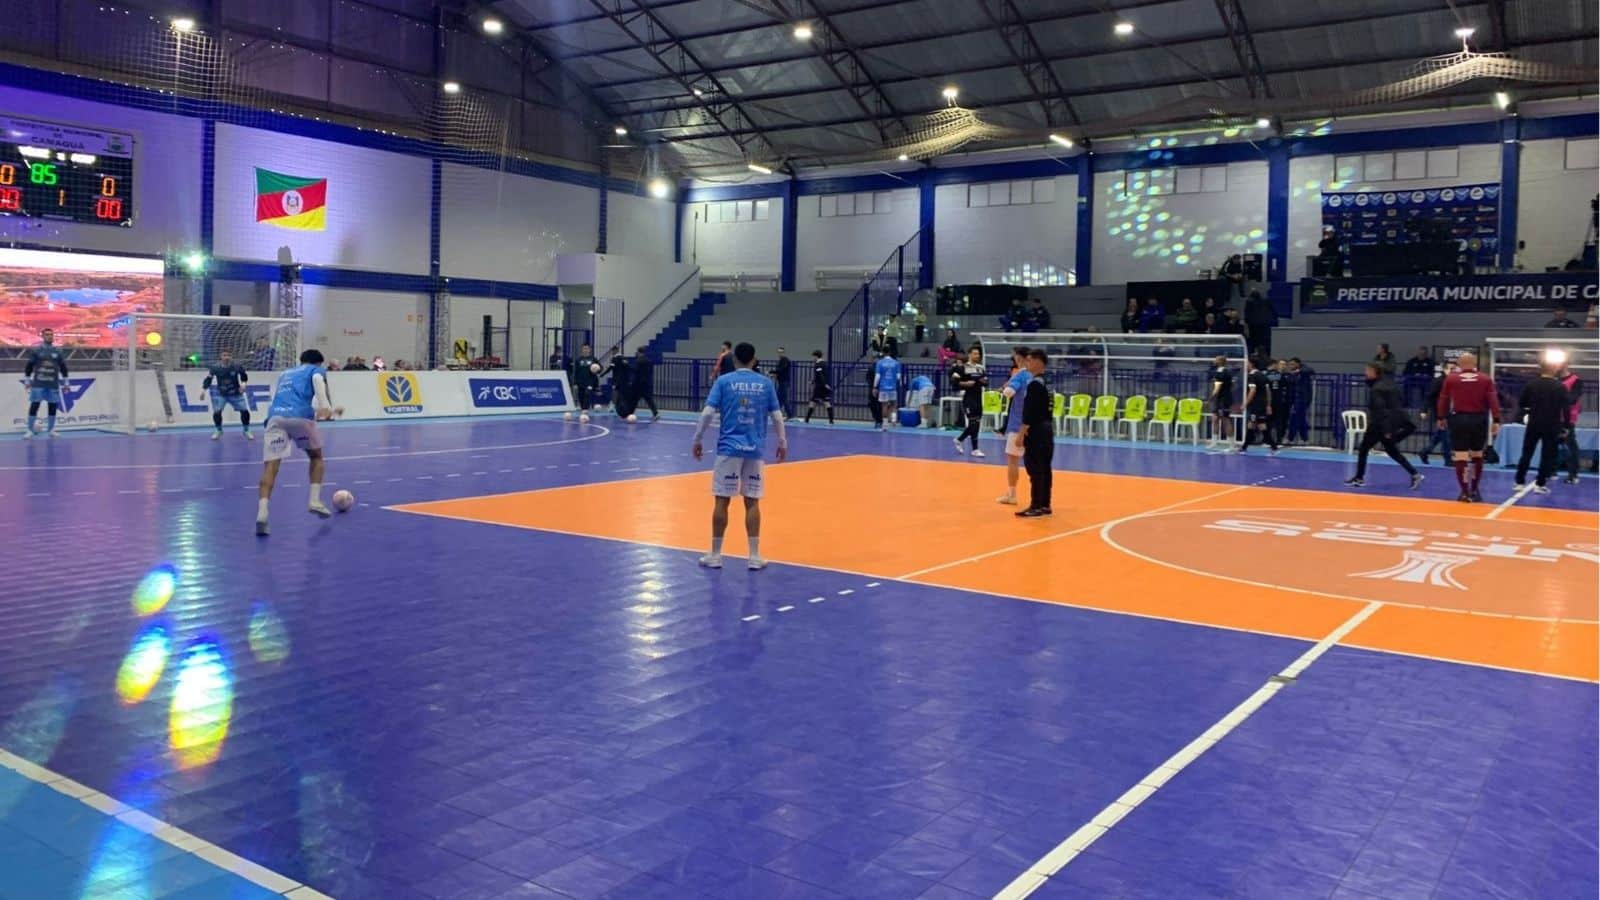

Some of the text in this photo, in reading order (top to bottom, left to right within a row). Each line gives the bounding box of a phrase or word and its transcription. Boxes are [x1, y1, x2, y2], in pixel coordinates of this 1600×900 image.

[31, 163, 56, 184] 85
[103, 177, 115, 197] 0
[97, 199, 121, 219] 00
[1337, 287, 1440, 301] PREFEITURA
[1443, 285, 1547, 300] MUNICIPAL
[1551, 284, 1579, 299] DE
[731, 382, 765, 392] VELEZ
